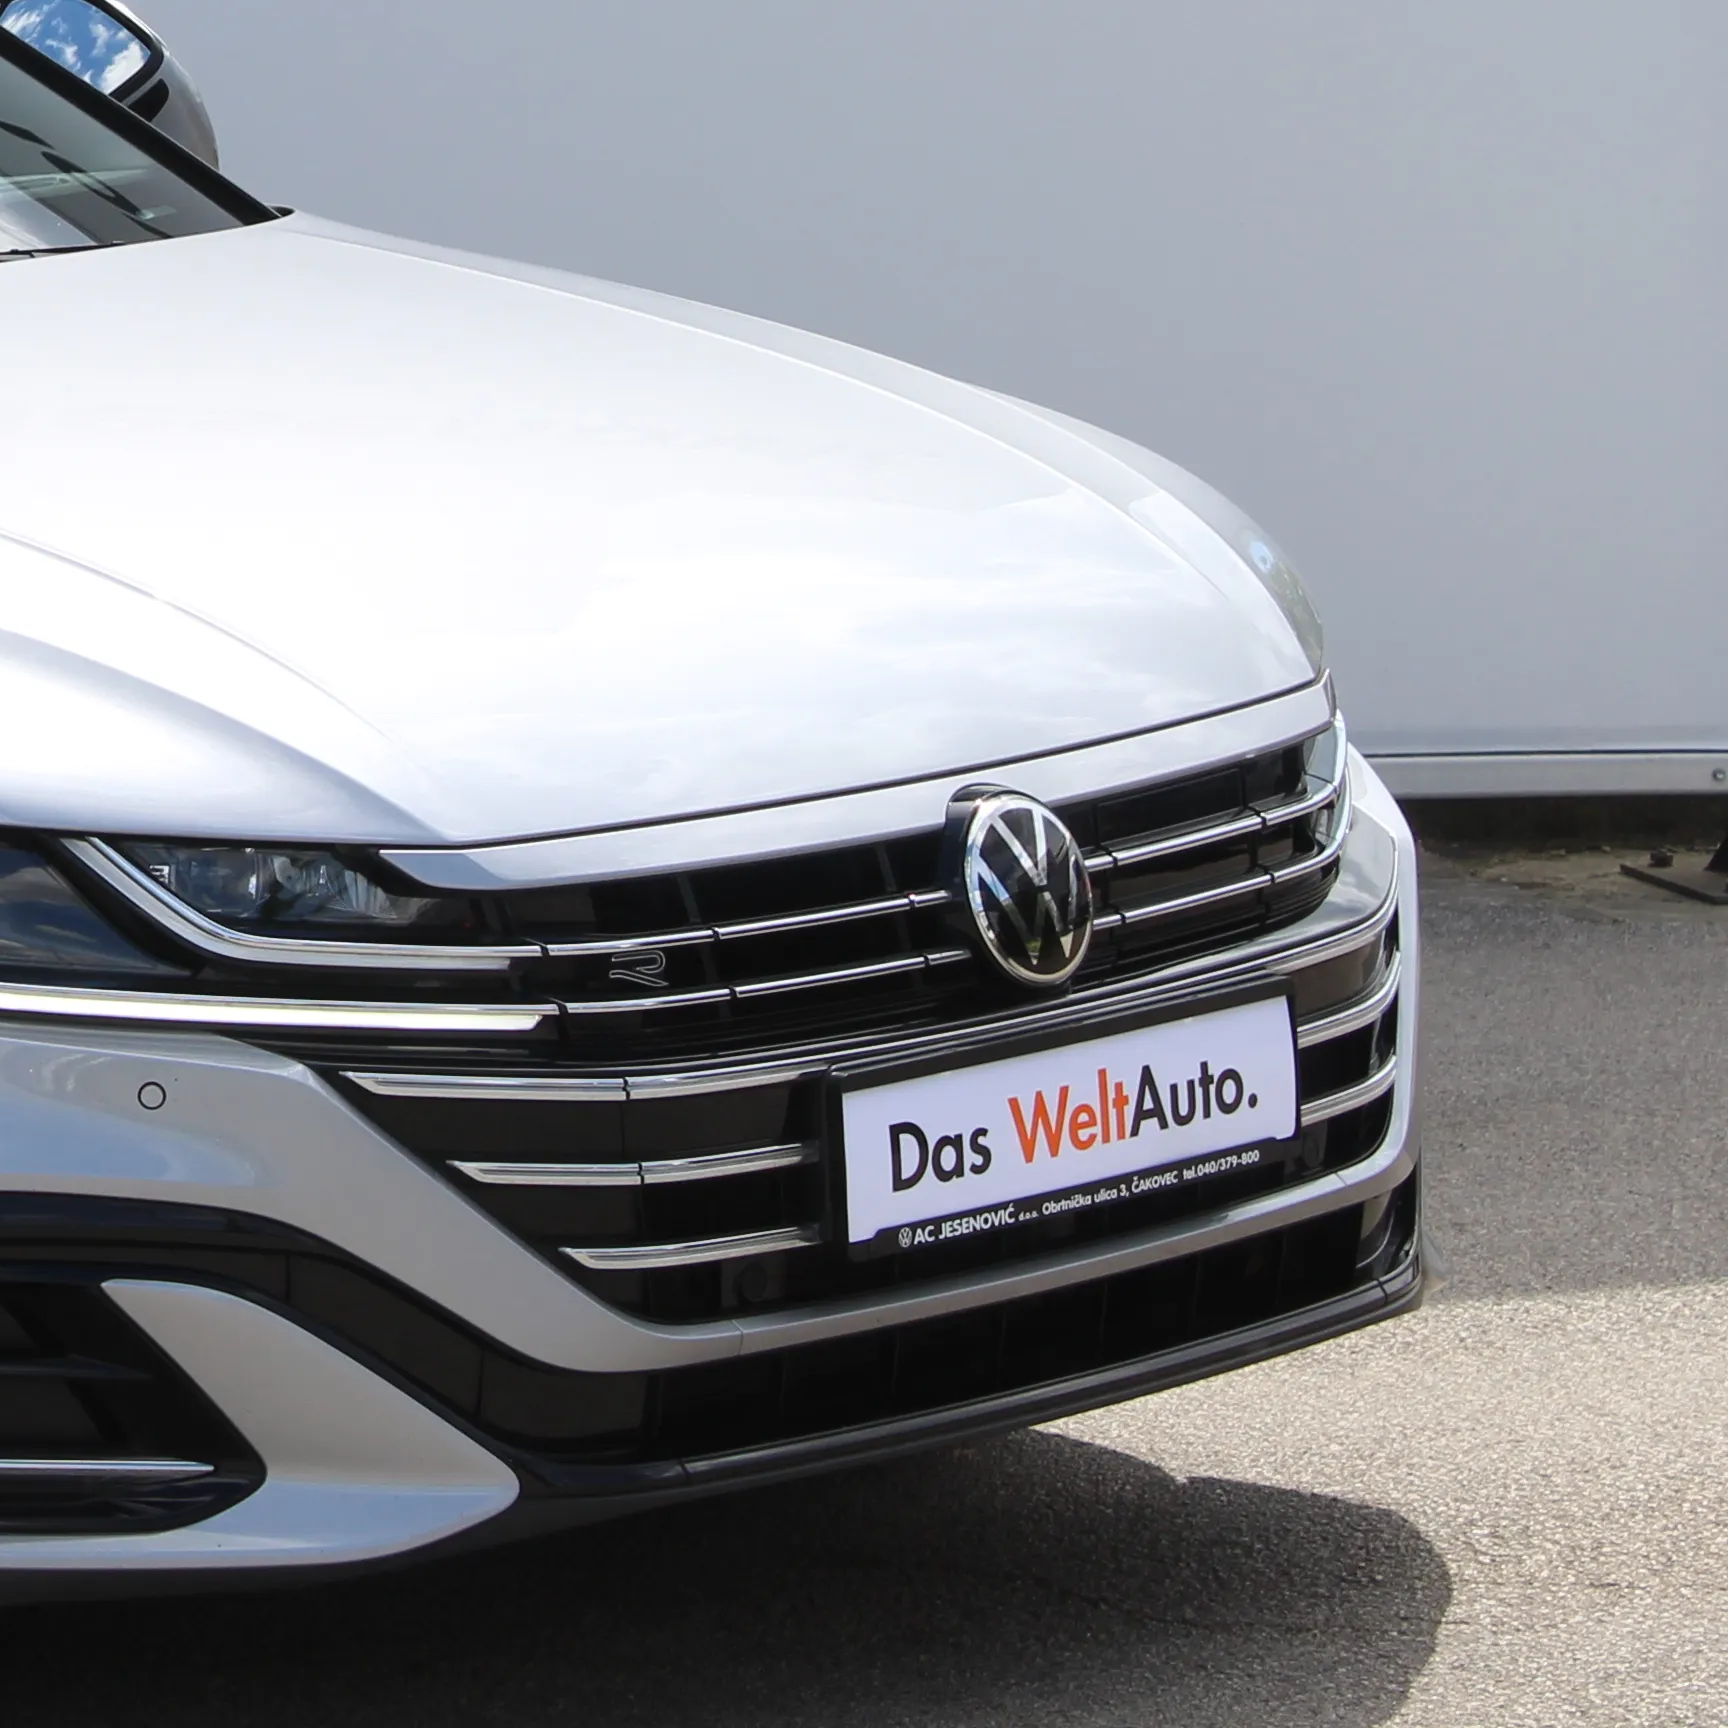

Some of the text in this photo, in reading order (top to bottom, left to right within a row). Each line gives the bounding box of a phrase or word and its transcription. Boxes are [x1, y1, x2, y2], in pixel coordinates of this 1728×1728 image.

[888, 1059, 1259, 1193] Das WeltAuto.
[913, 1225, 935, 1245] AC
[938, 1202, 1016, 1239] JESENOVIĆ
[1041, 1193, 1093, 1216] Obrtnička
[1094, 1185, 1118, 1204] ulica
[1131, 1170, 1180, 1194] ČAKOVEC
